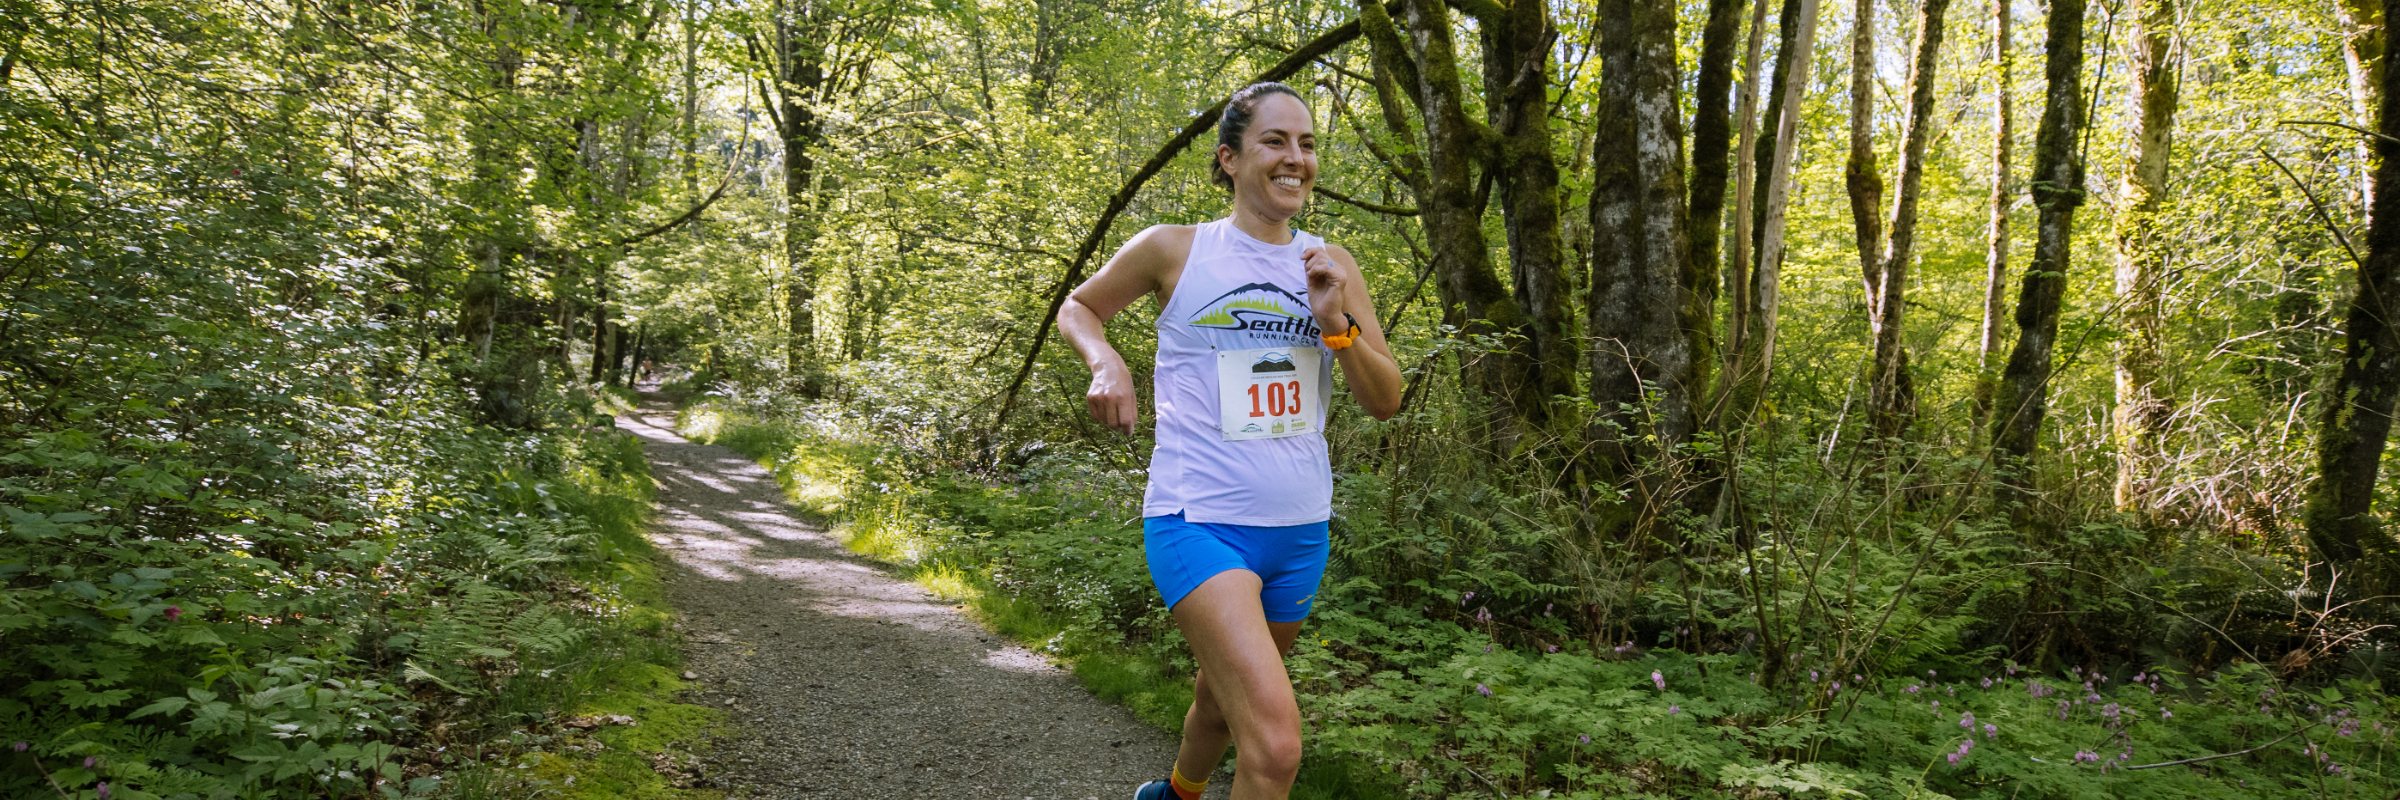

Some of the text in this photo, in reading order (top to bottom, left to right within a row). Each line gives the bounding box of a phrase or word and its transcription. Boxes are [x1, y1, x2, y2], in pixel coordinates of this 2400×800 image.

[1231, 310, 1321, 339] Seattle
[1249, 332, 1296, 342] RUNNING
[1247, 380, 1301, 417] 103
